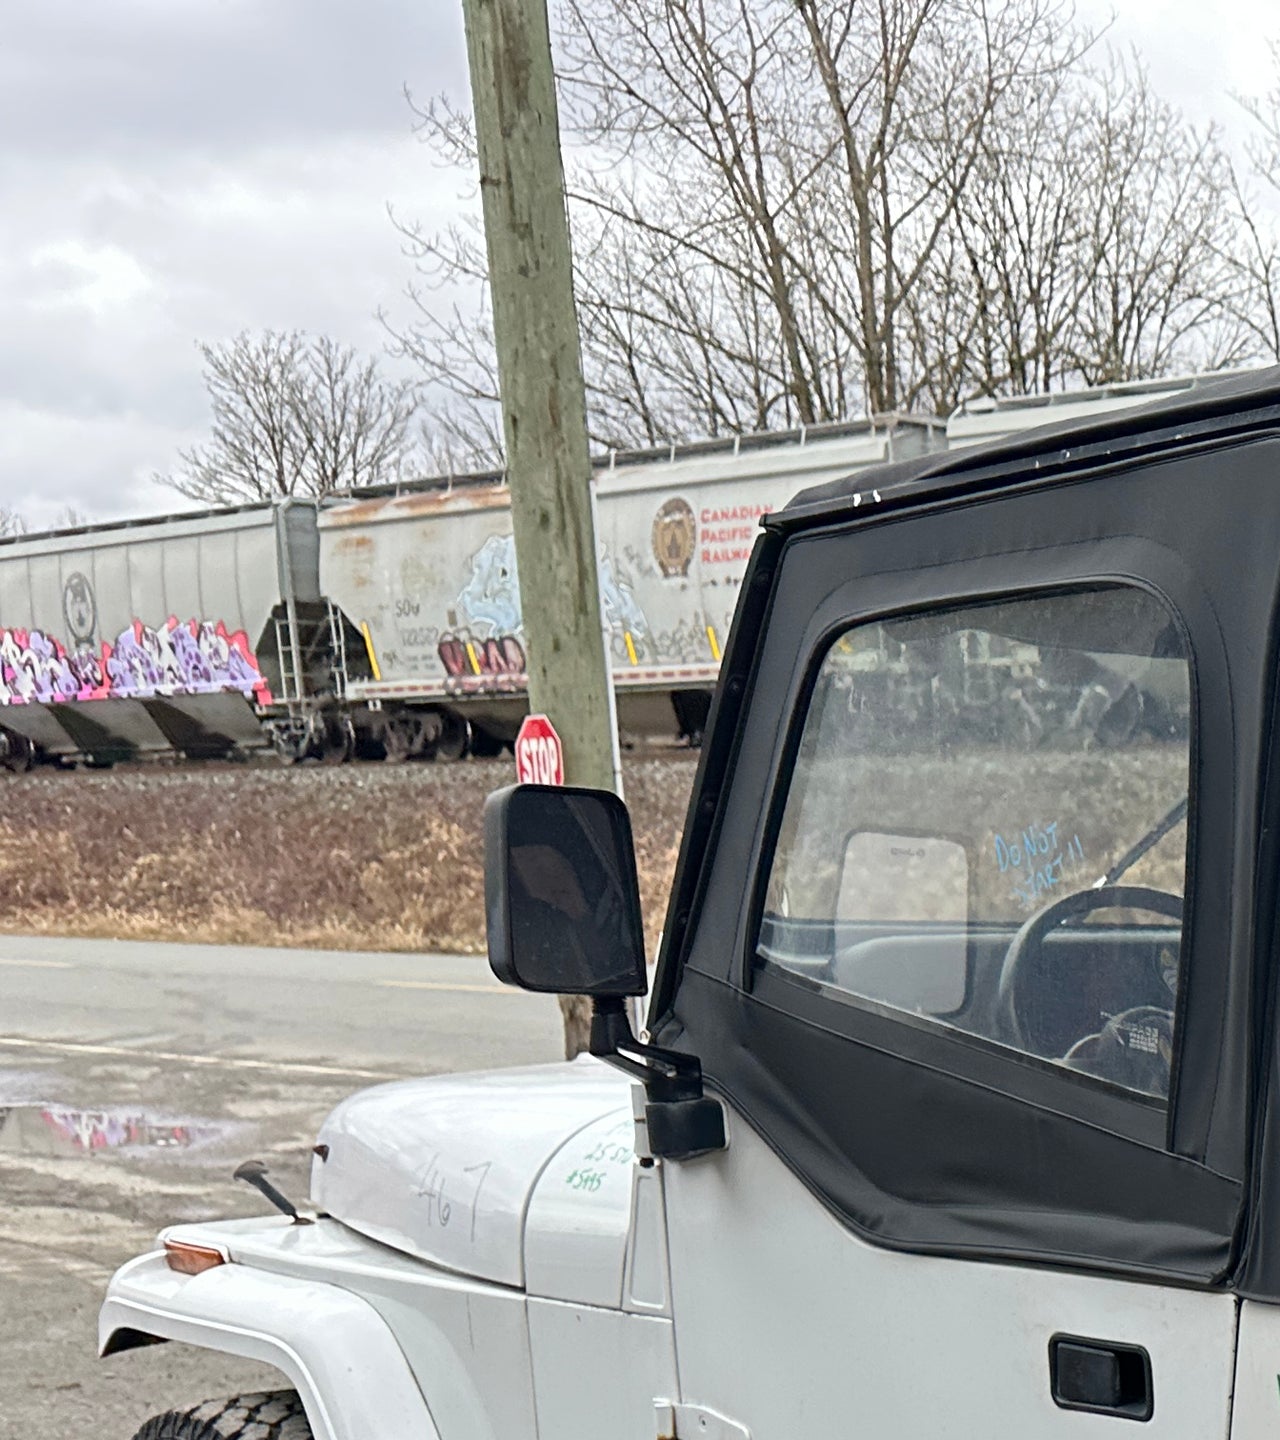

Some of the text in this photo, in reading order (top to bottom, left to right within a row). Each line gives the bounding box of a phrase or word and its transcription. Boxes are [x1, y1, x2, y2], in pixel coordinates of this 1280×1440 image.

[701, 504, 774, 523] CANADIAN
[701, 526, 752, 543] PACIFIC
[701, 548, 751, 564] RAILWA
[519, 737, 558, 784] STOP
